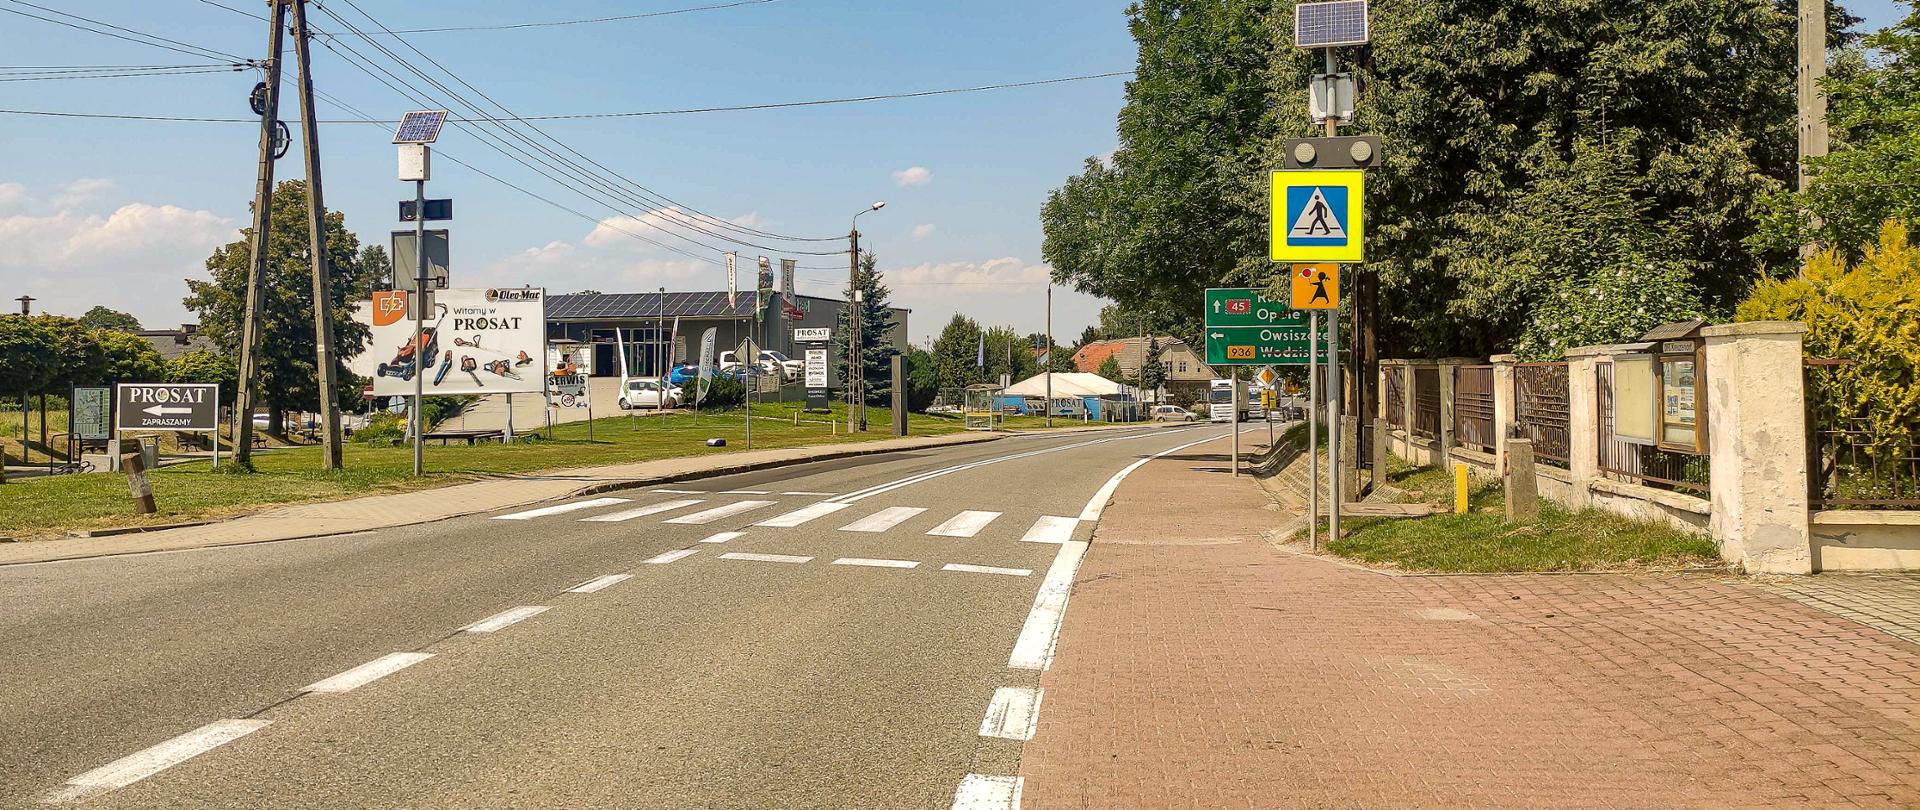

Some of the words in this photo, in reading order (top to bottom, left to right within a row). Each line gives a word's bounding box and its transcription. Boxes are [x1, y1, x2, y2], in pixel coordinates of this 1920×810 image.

[498, 290, 541, 300] Oleo-Mac
[453, 307, 487, 316] Witamy
[1231, 302, 1245, 311] 45
[454, 317, 522, 331] PROSAT
[796, 329, 828, 337] PROSAT
[1231, 347, 1251, 357] 936
[548, 375, 586, 386] SERWIS
[129, 387, 207, 404] PROSAT
[1051, 398, 1082, 408] PROSAT
[141, 418, 192, 426] ZAPRASZAMY
